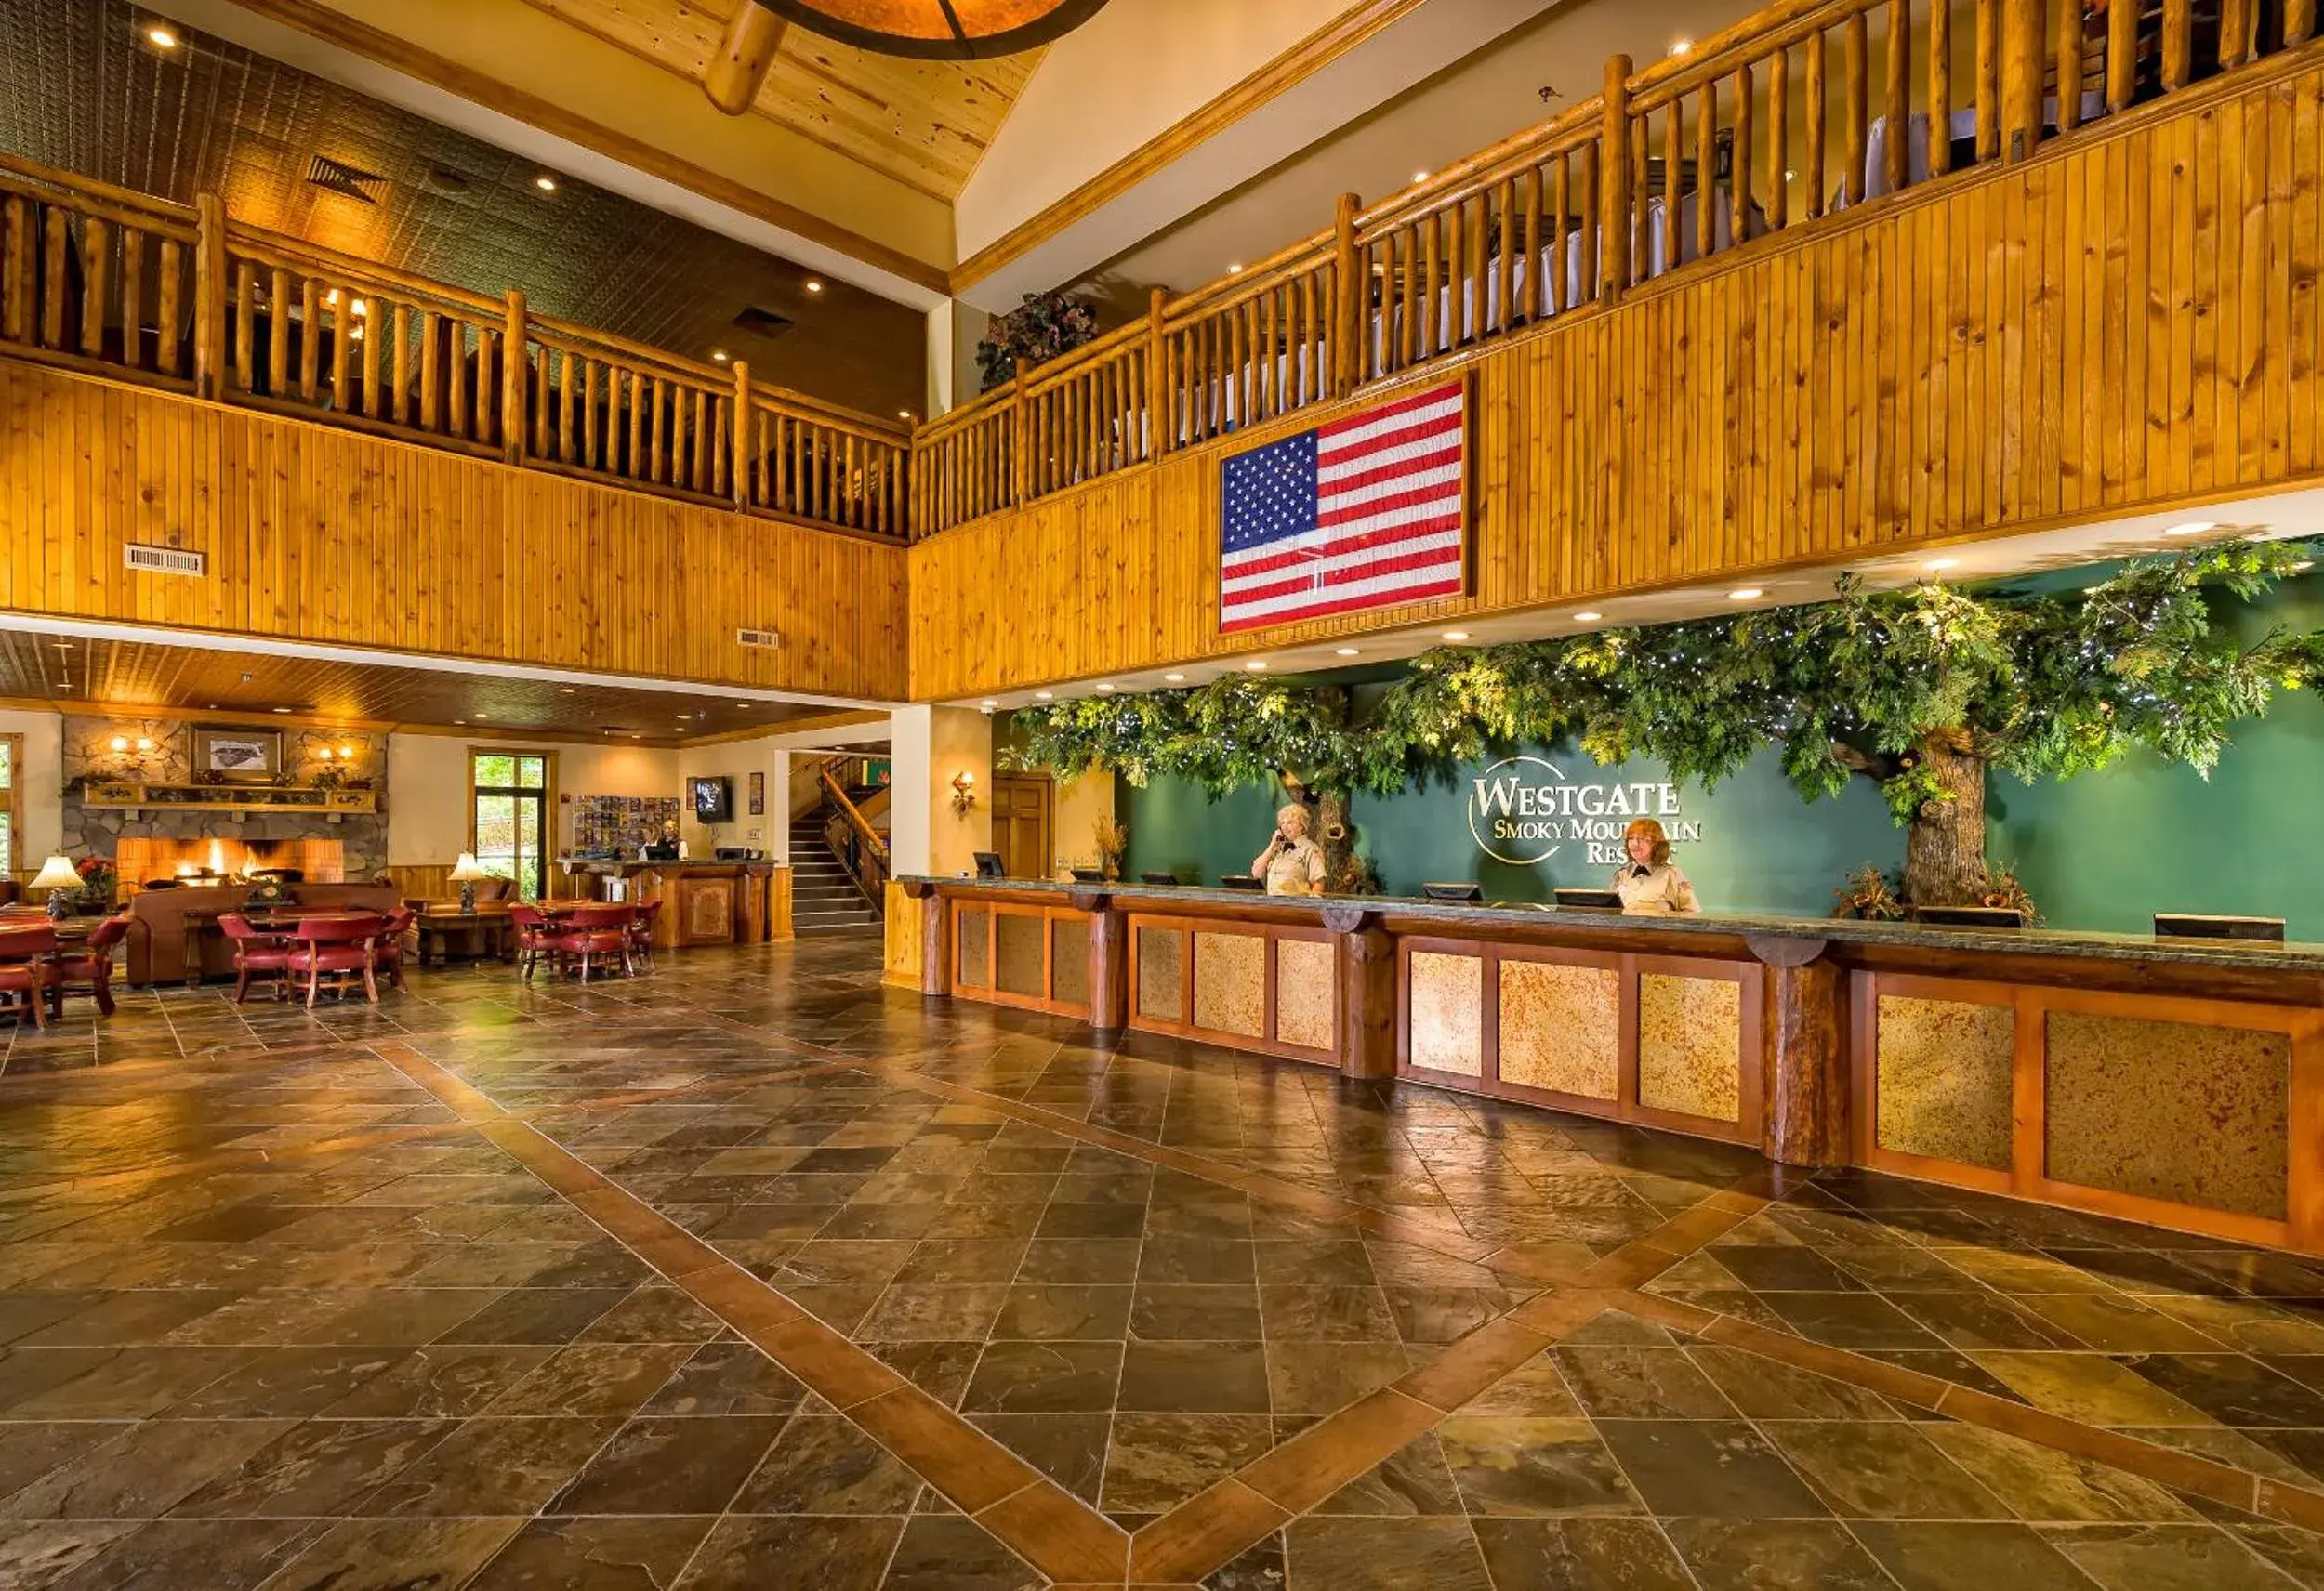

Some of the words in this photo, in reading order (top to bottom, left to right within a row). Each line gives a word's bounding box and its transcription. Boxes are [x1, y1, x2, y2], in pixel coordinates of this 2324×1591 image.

[1473, 777, 1681, 818] WESTGATE
[1494, 819, 1564, 840] SMOKY
[1569, 818, 1701, 841] MOUAIN
